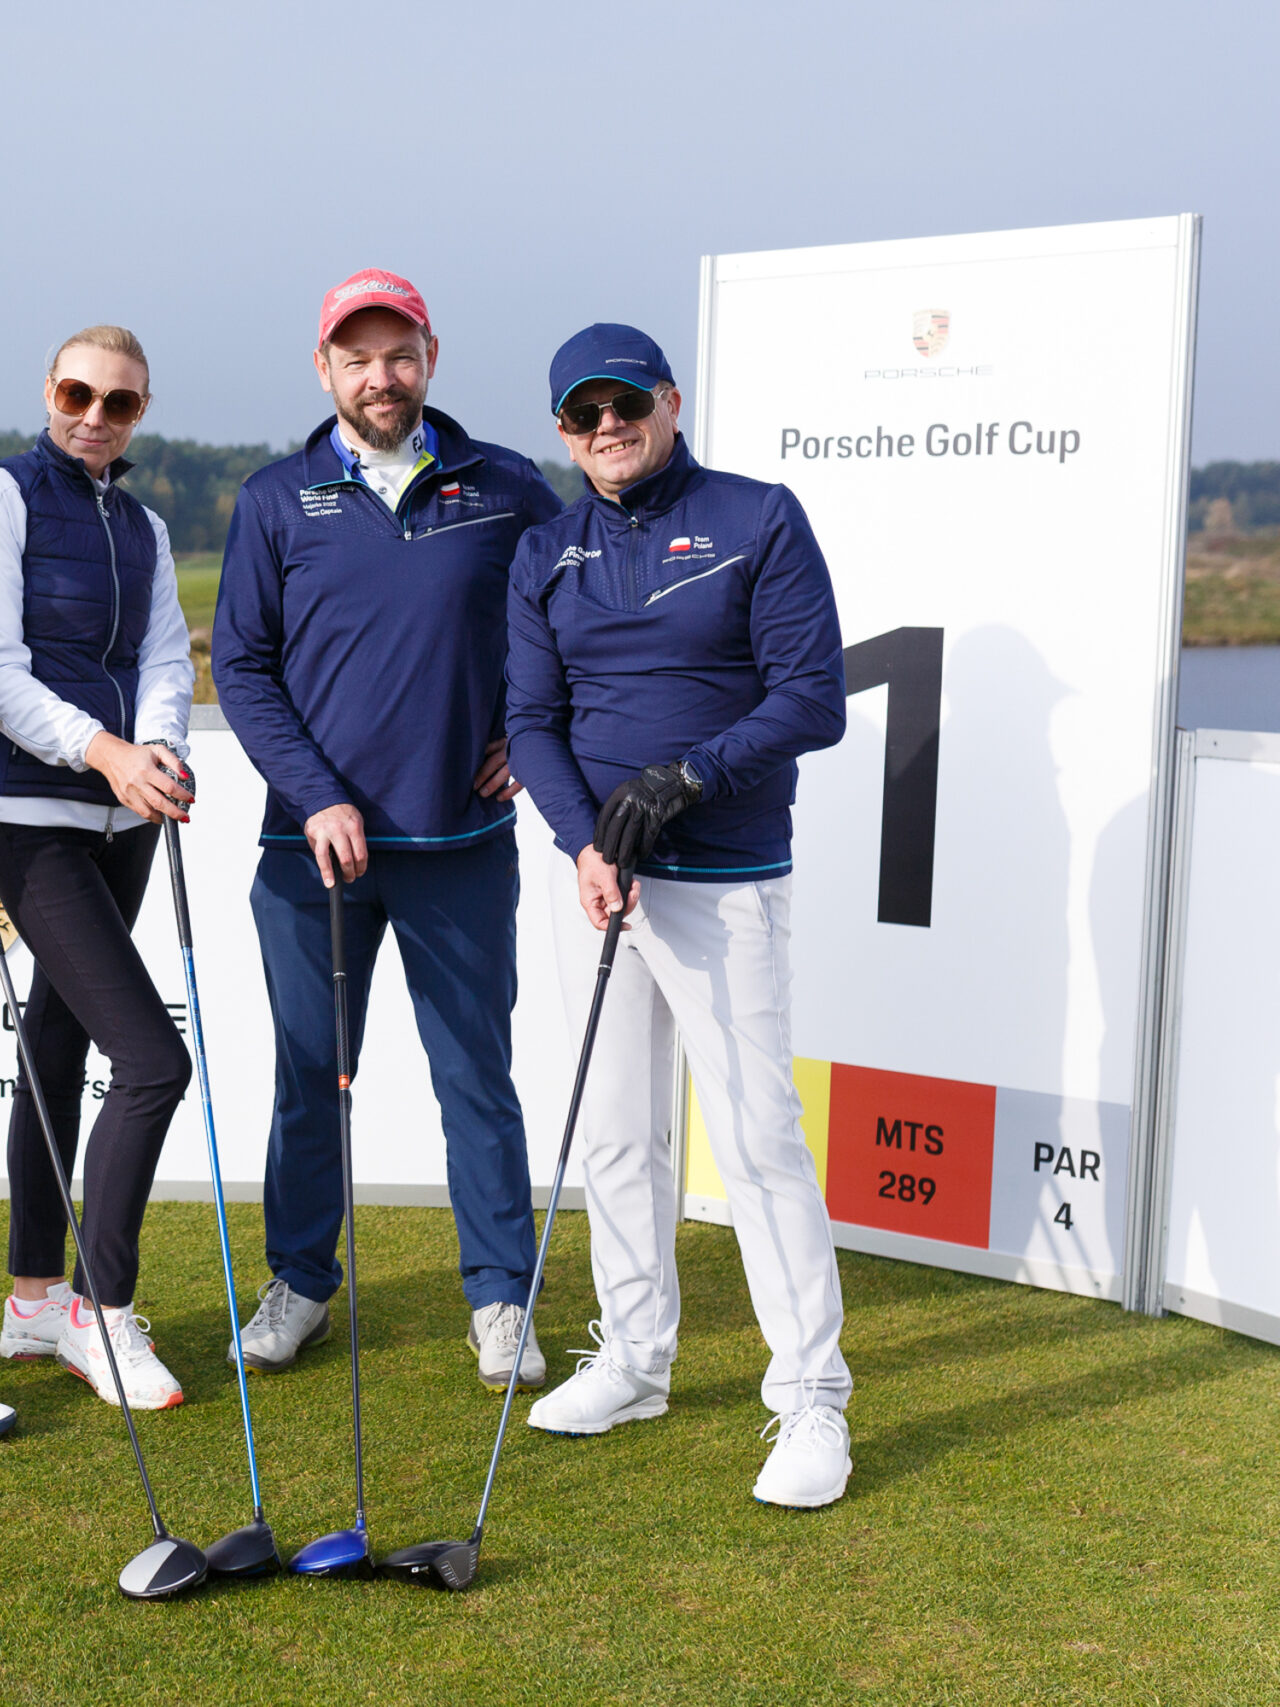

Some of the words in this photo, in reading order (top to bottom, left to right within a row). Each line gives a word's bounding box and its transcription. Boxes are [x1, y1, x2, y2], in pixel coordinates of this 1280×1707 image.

[864, 364, 994, 380] PORSCHE
[780, 426, 915, 460] Porsche
[926, 422, 1000, 457] Golf
[1008, 420, 1081, 464] Cup
[693, 542, 713, 550] Poland
[694, 535, 710, 543] Team
[842, 626, 945, 928] 1
[875, 1116, 944, 1156] MTS
[1033, 1141, 1101, 1182] PAR
[878, 1170, 937, 1206] 289
[1053, 1202, 1074, 1231] 4
